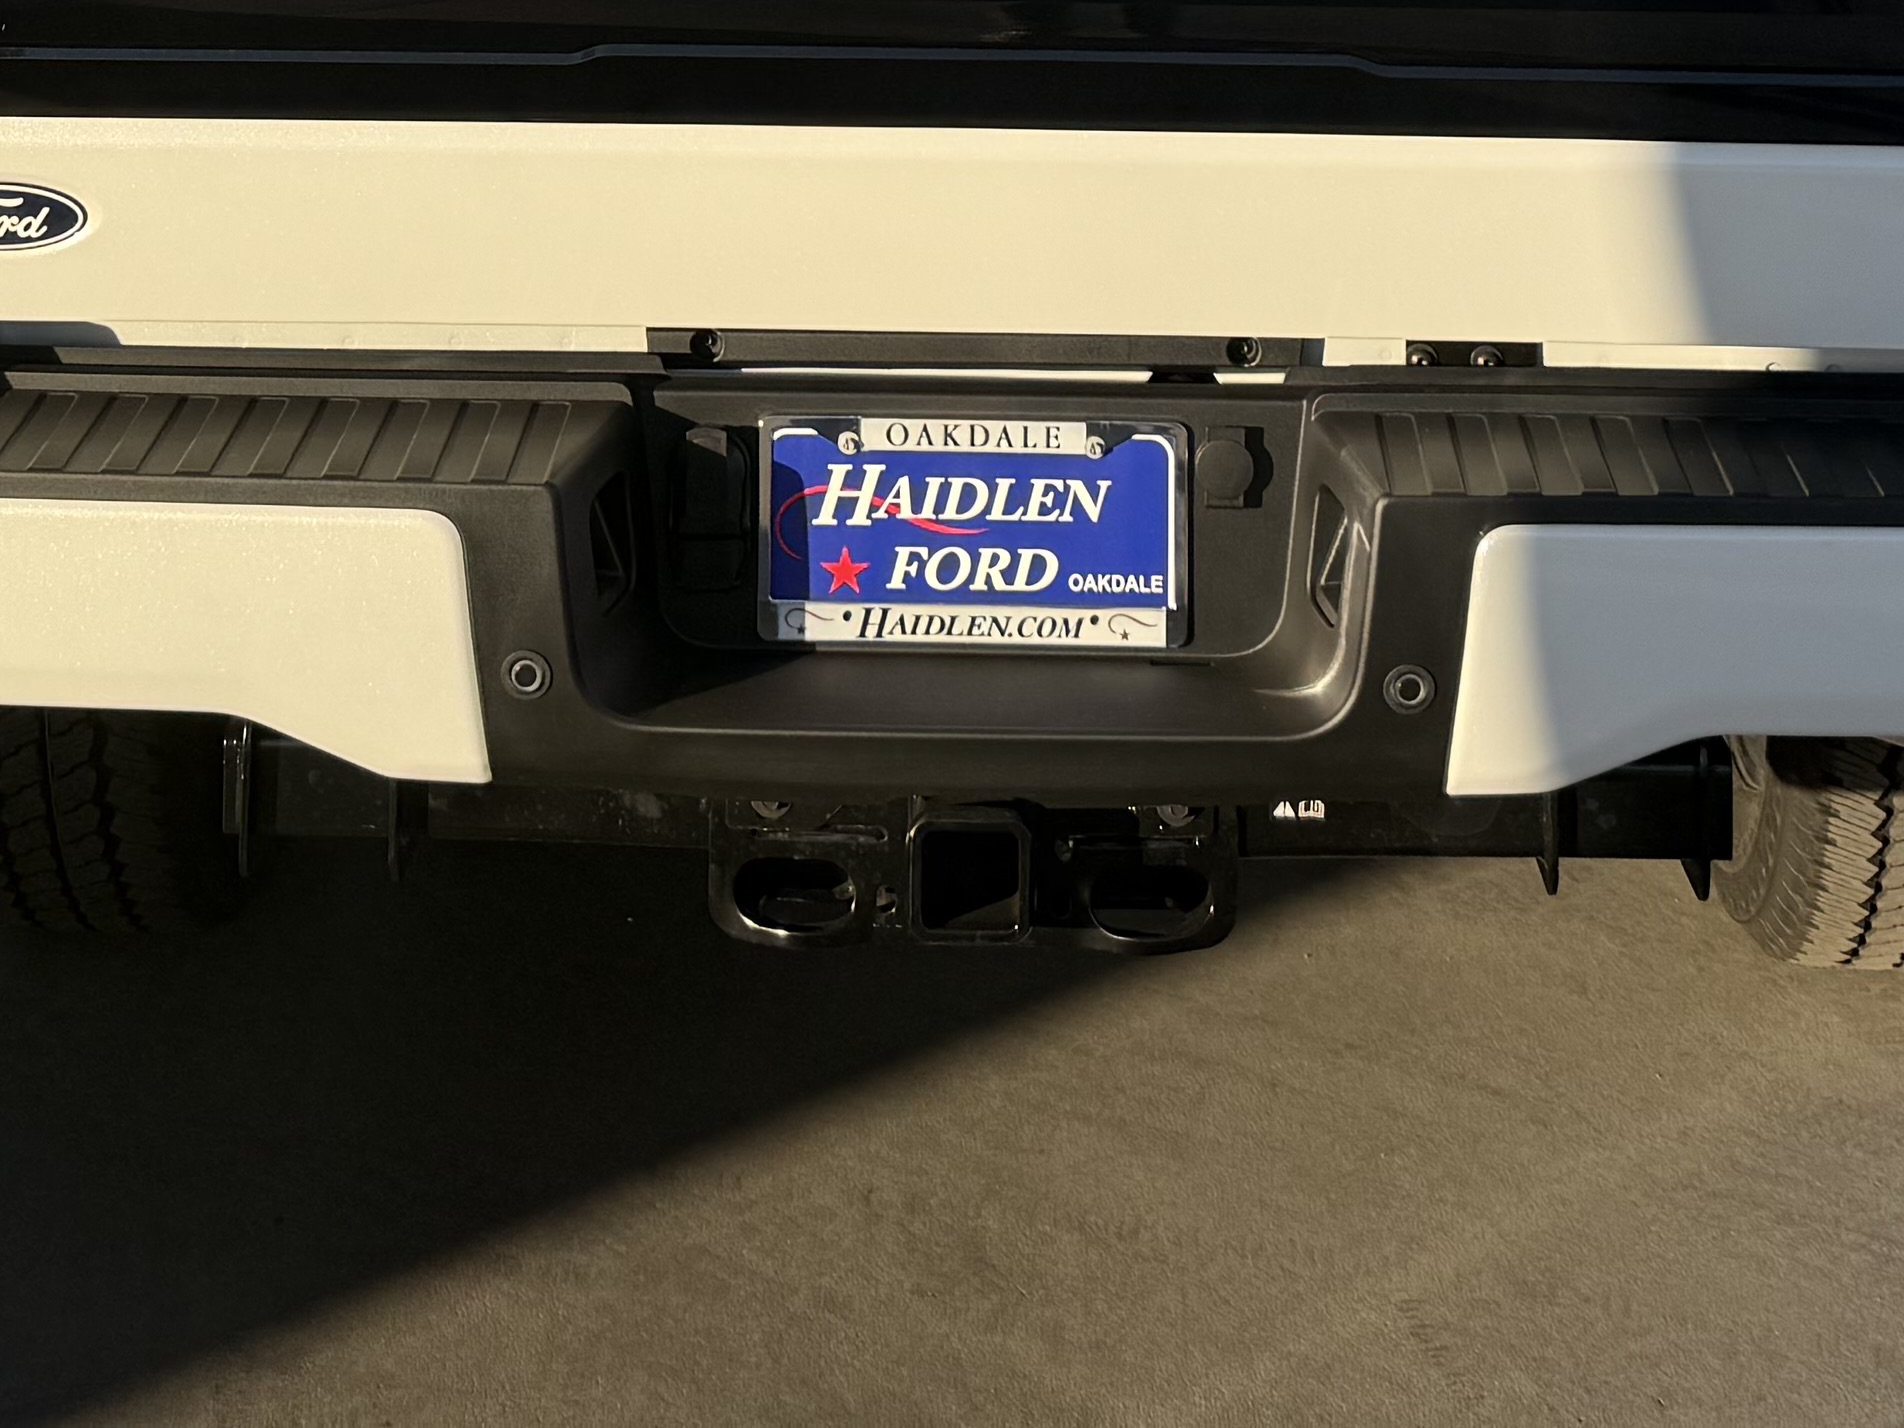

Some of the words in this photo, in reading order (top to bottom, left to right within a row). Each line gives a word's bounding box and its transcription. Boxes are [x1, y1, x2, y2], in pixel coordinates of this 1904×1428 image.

[885, 421, 1062, 450] OAKDALE
[811, 462, 1112, 527] HAIDLEN
[885, 545, 1060, 592] FORD
[1067, 573, 1164, 594] OAKDALE
[856, 606, 1084, 639] HAIDLEN.COM
